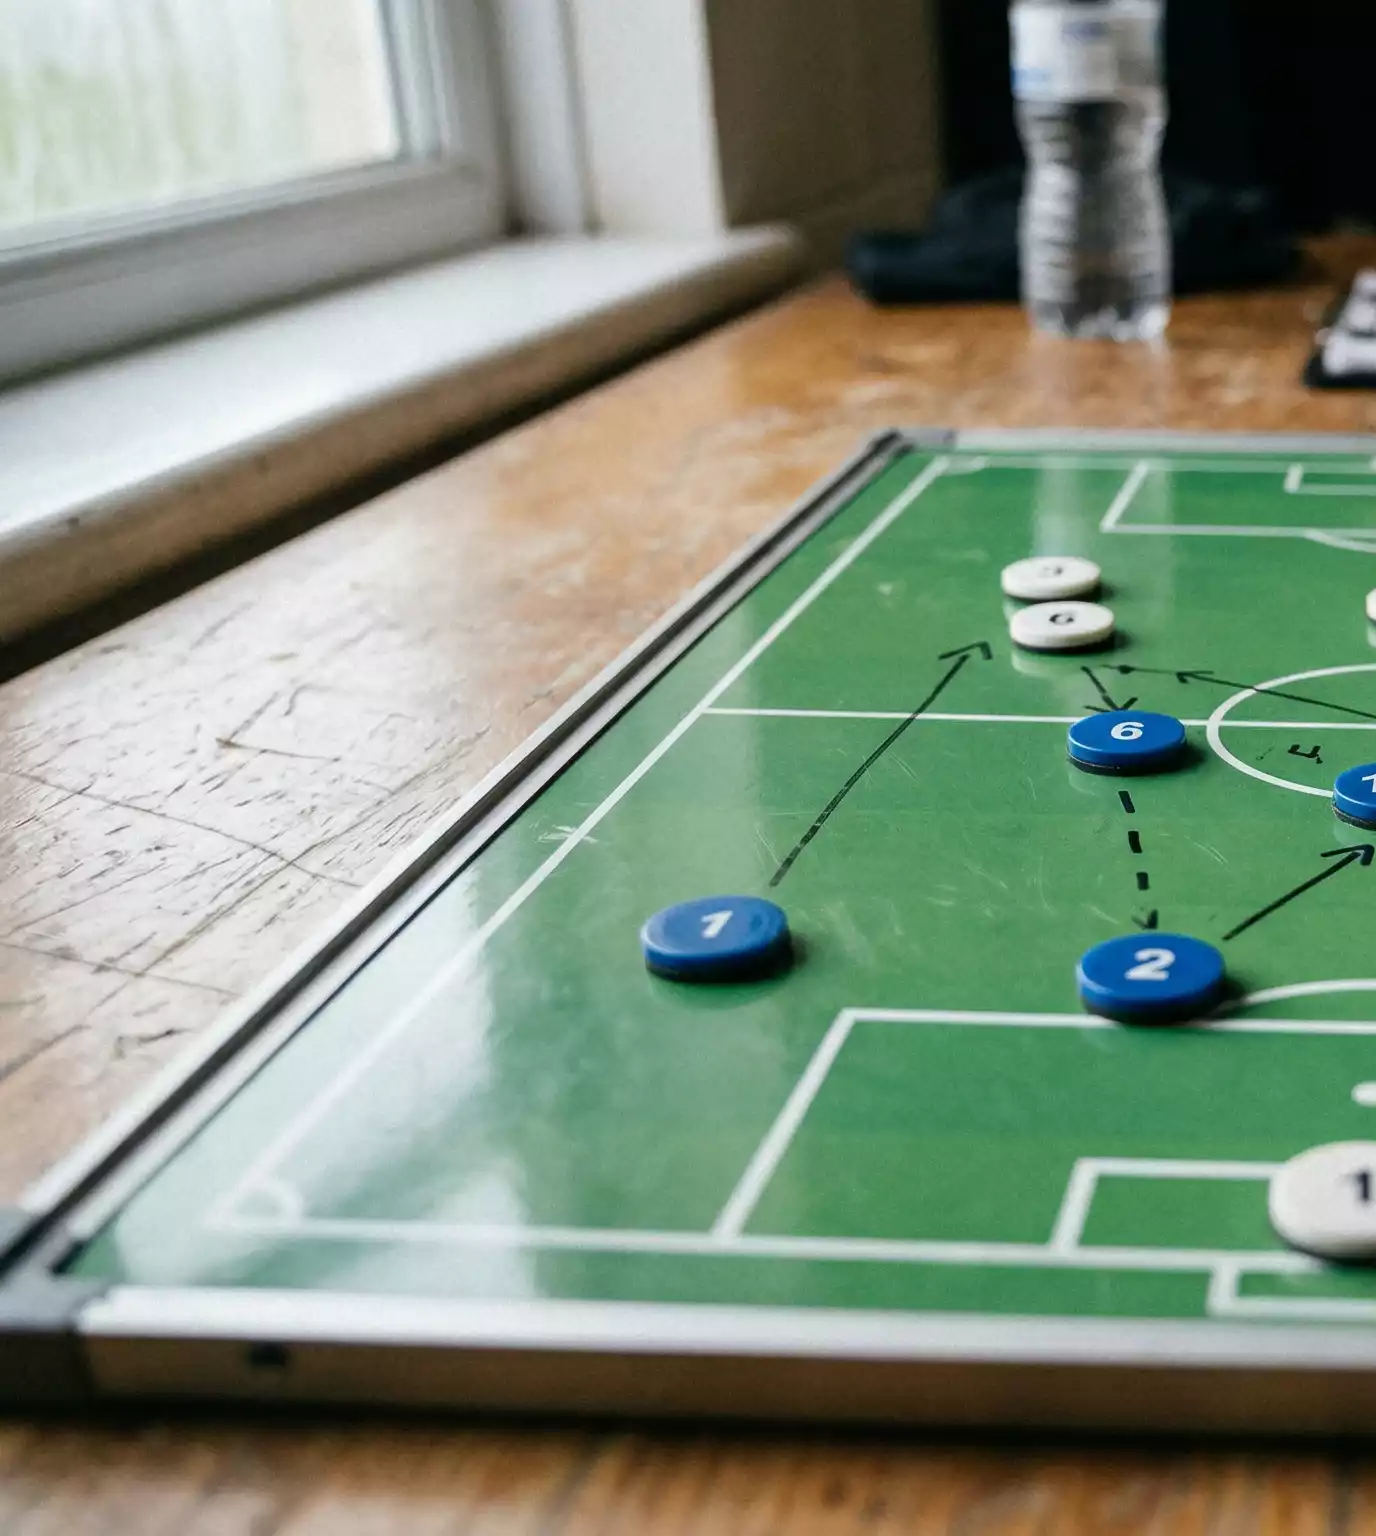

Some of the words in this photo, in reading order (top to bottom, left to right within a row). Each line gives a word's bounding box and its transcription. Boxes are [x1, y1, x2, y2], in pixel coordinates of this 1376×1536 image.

[1110, 721, 1145, 741] 6
[701, 910, 734, 939] 1
[1123, 947, 1176, 981] 2
[1344, 1169, 1372, 1204] 1
